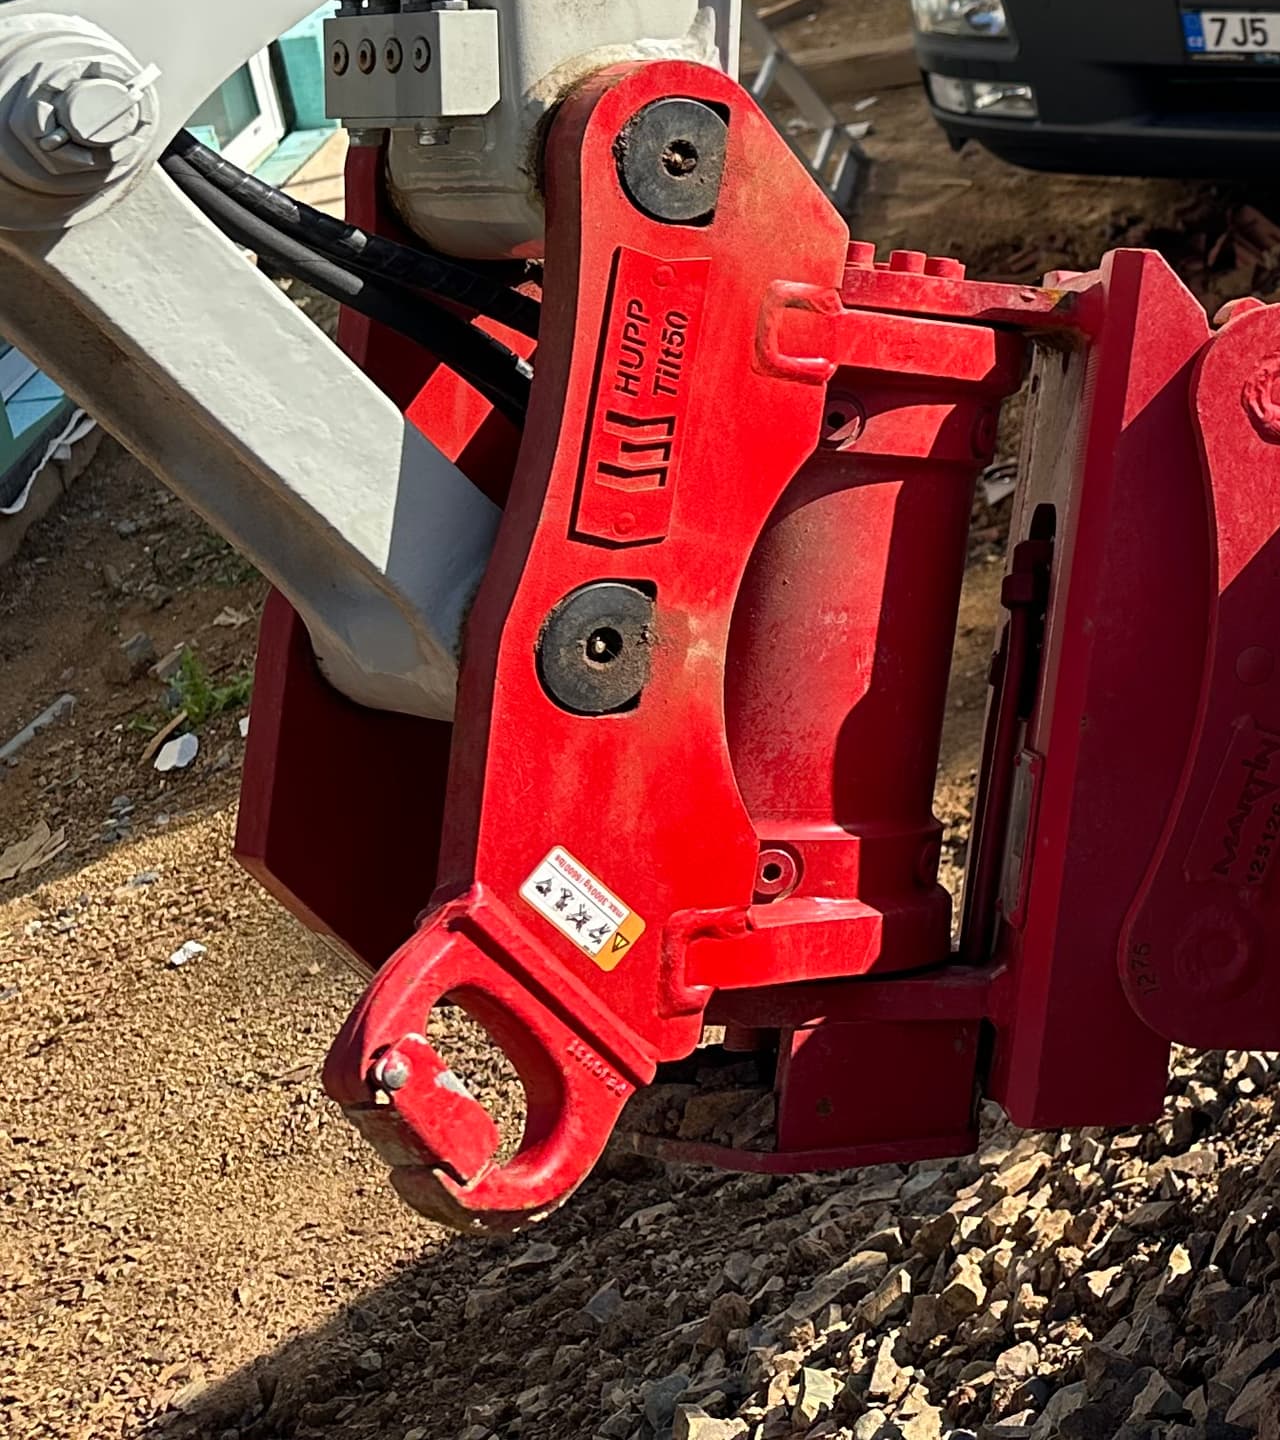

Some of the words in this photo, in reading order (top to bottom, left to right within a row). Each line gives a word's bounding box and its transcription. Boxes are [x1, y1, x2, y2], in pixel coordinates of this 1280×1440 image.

[1209, 17, 1268, 47] 7J5
[614, 298, 650, 397] HUPP
[652, 310, 689, 396] Tilt50
